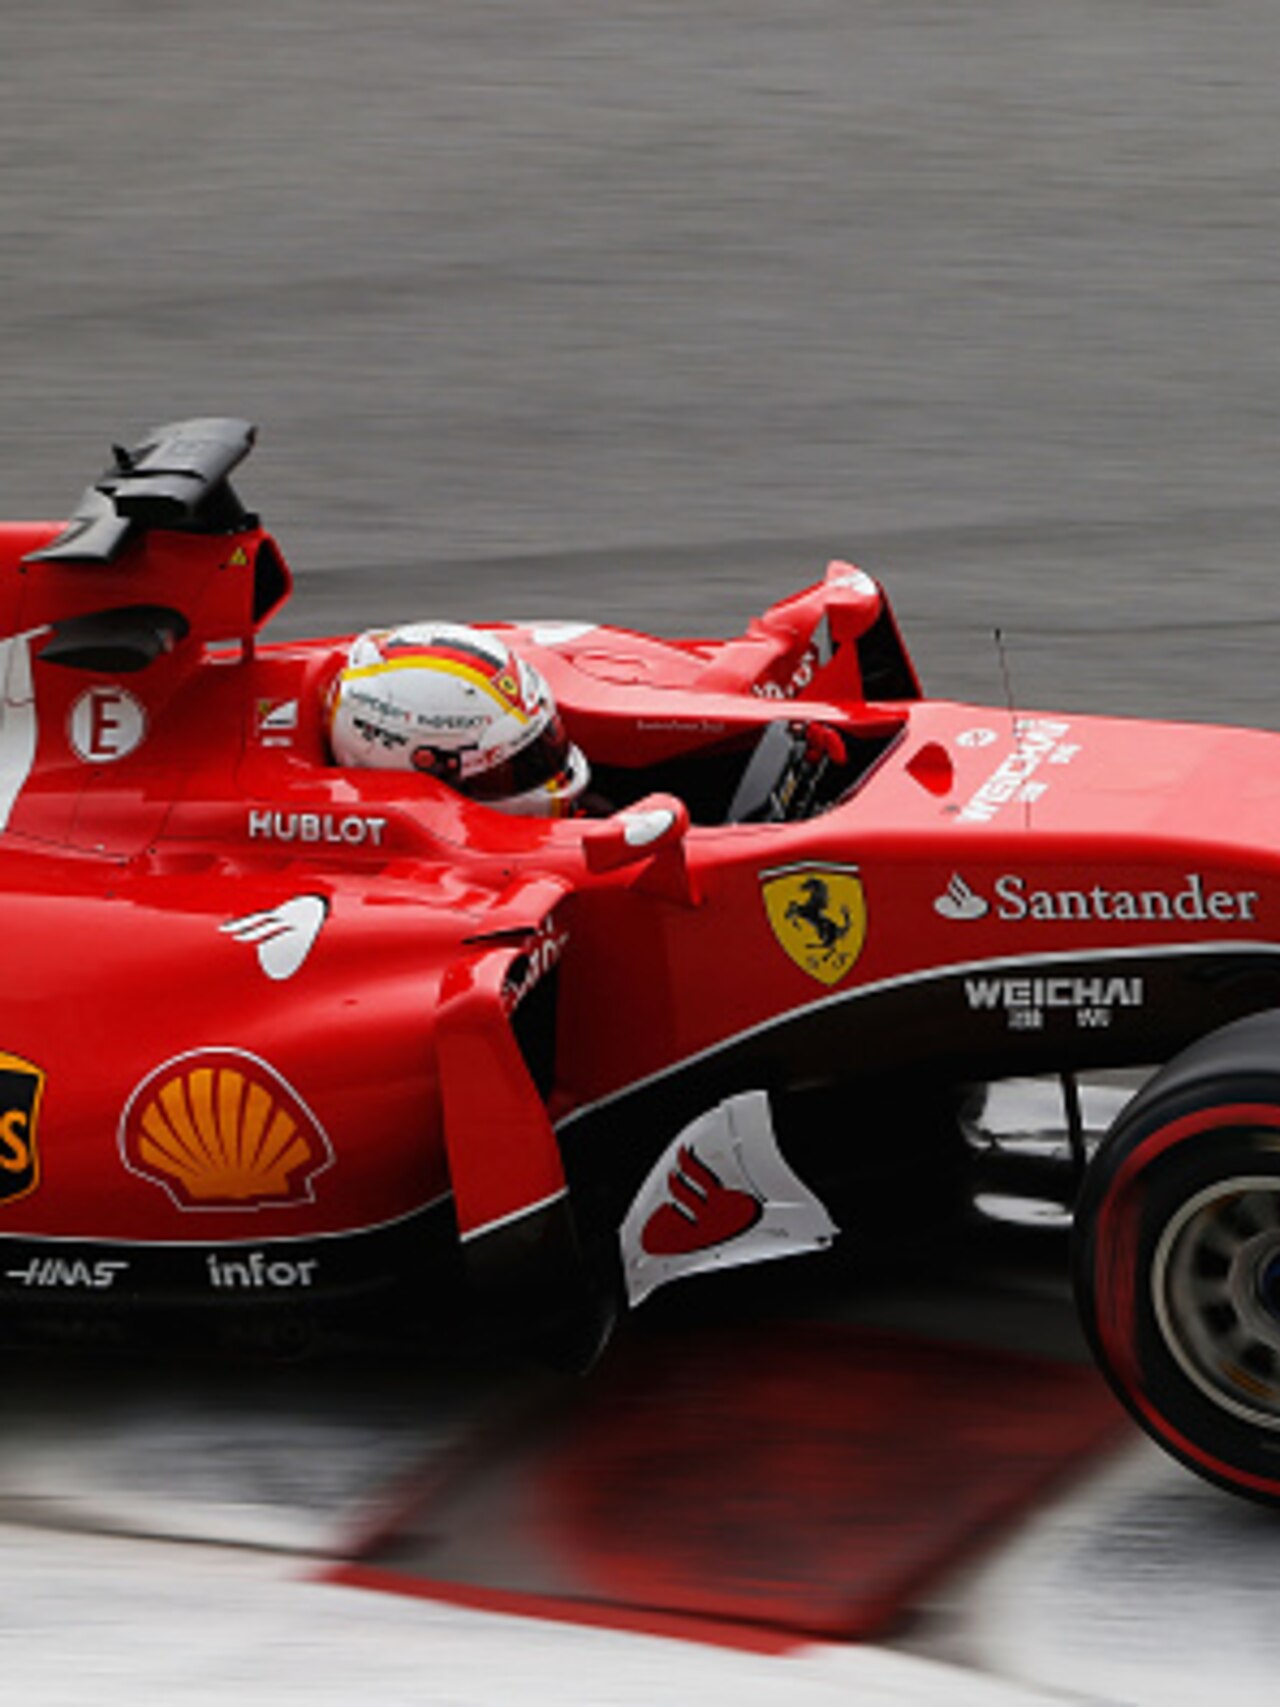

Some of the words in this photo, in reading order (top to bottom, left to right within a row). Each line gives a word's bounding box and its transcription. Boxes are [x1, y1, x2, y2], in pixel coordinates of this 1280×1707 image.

[90, 694, 122, 753] E
[249, 810, 386, 845] HUBLOT
[995, 874, 1258, 919] Santander
[965, 978, 1143, 1008] WEICHAI
[0, 1110, 28, 1173] S
[207, 1253, 318, 1286] infor
